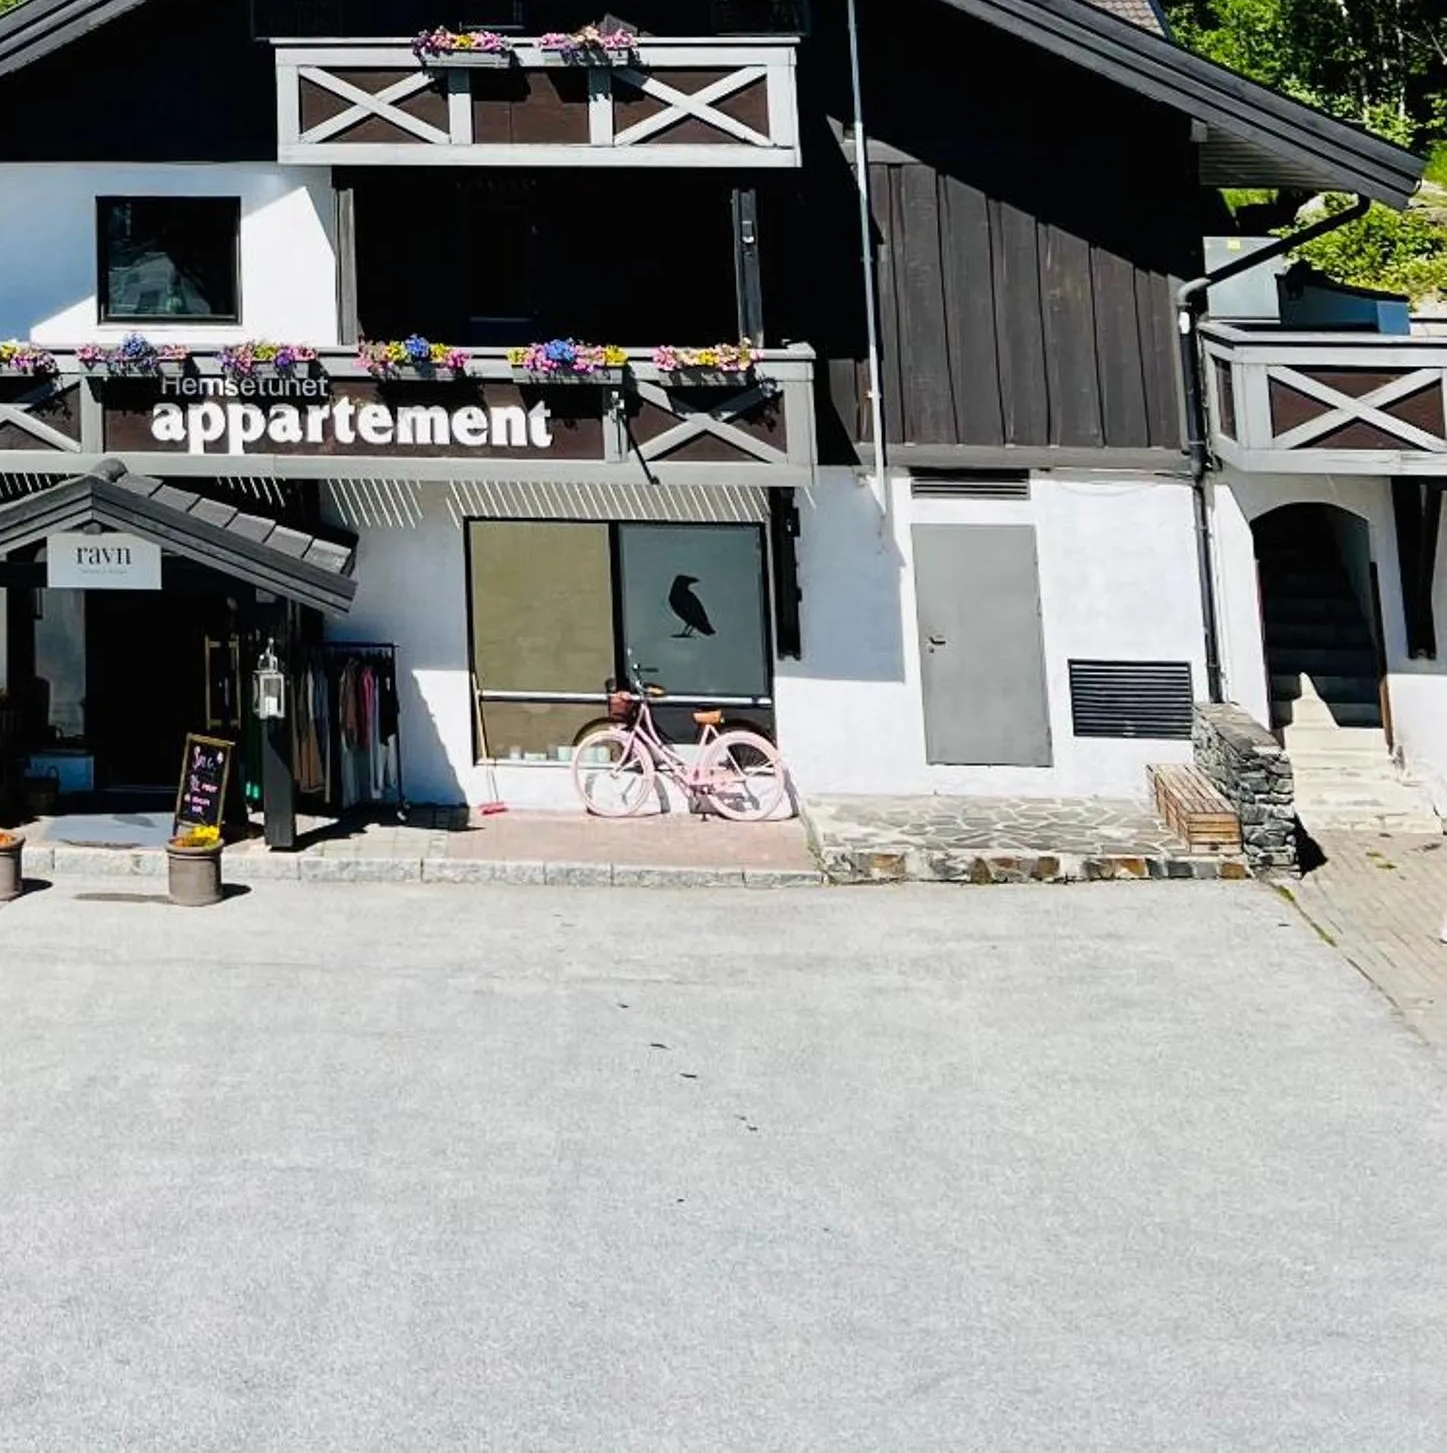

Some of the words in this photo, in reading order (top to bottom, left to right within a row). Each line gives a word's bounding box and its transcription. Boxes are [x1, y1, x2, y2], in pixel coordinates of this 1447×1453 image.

[161, 375, 329, 397] Hemsetunet
[151, 396, 552, 455] appartement
[76, 547, 132, 565] ravn
